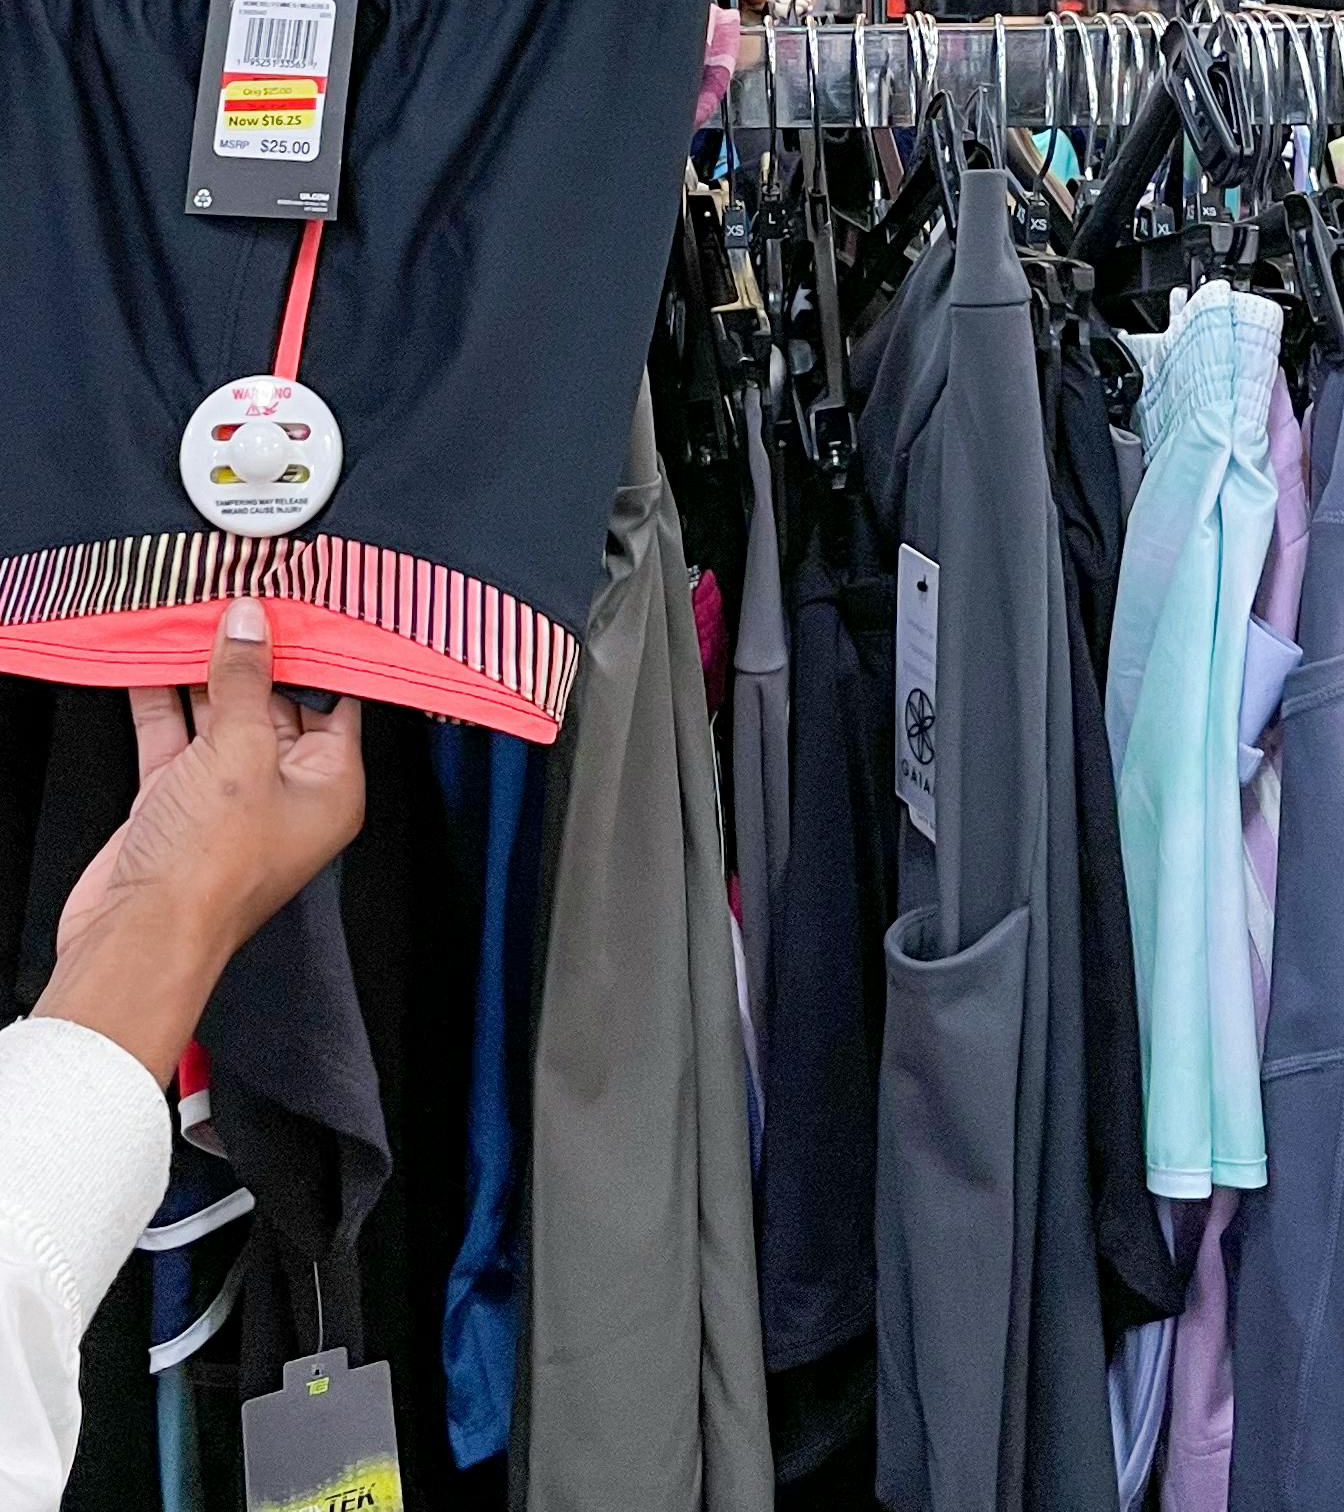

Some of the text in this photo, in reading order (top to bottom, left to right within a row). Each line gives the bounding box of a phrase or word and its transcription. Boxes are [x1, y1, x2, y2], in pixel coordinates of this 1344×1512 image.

[228, 114, 302, 127] Now $16.25
[219, 139, 311, 155] MSRP $25.00
[768, 212, 776, 224] L
[1030, 218, 1048, 231] XS
[726, 225, 745, 237] XS
[1157, 223, 1174, 236] XL
